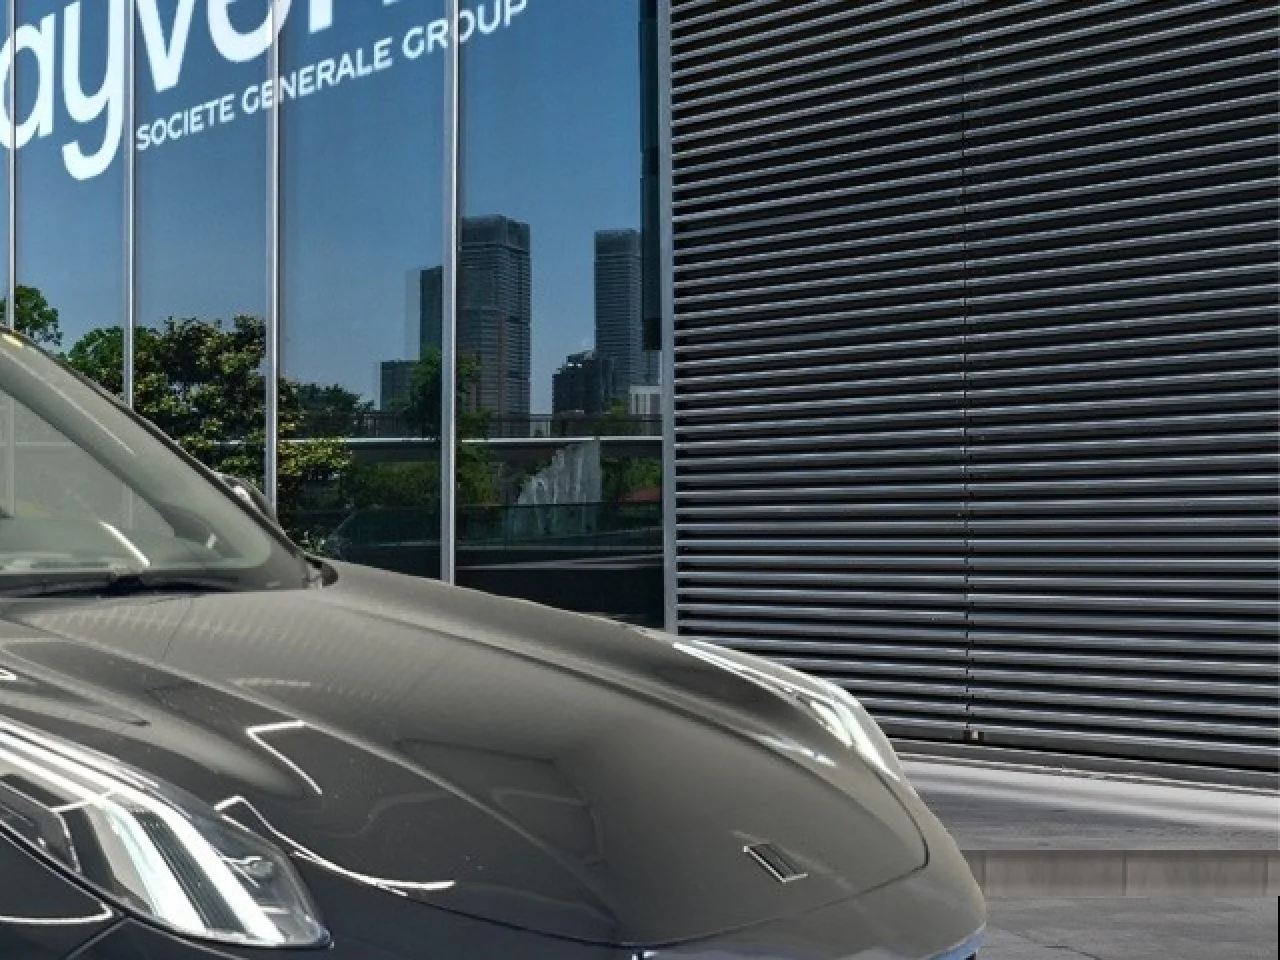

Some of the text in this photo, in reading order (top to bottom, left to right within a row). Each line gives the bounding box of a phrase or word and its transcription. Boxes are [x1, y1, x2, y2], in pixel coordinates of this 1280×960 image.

[135, 0, 527, 151] SOCIETE GENERALE GROUP
